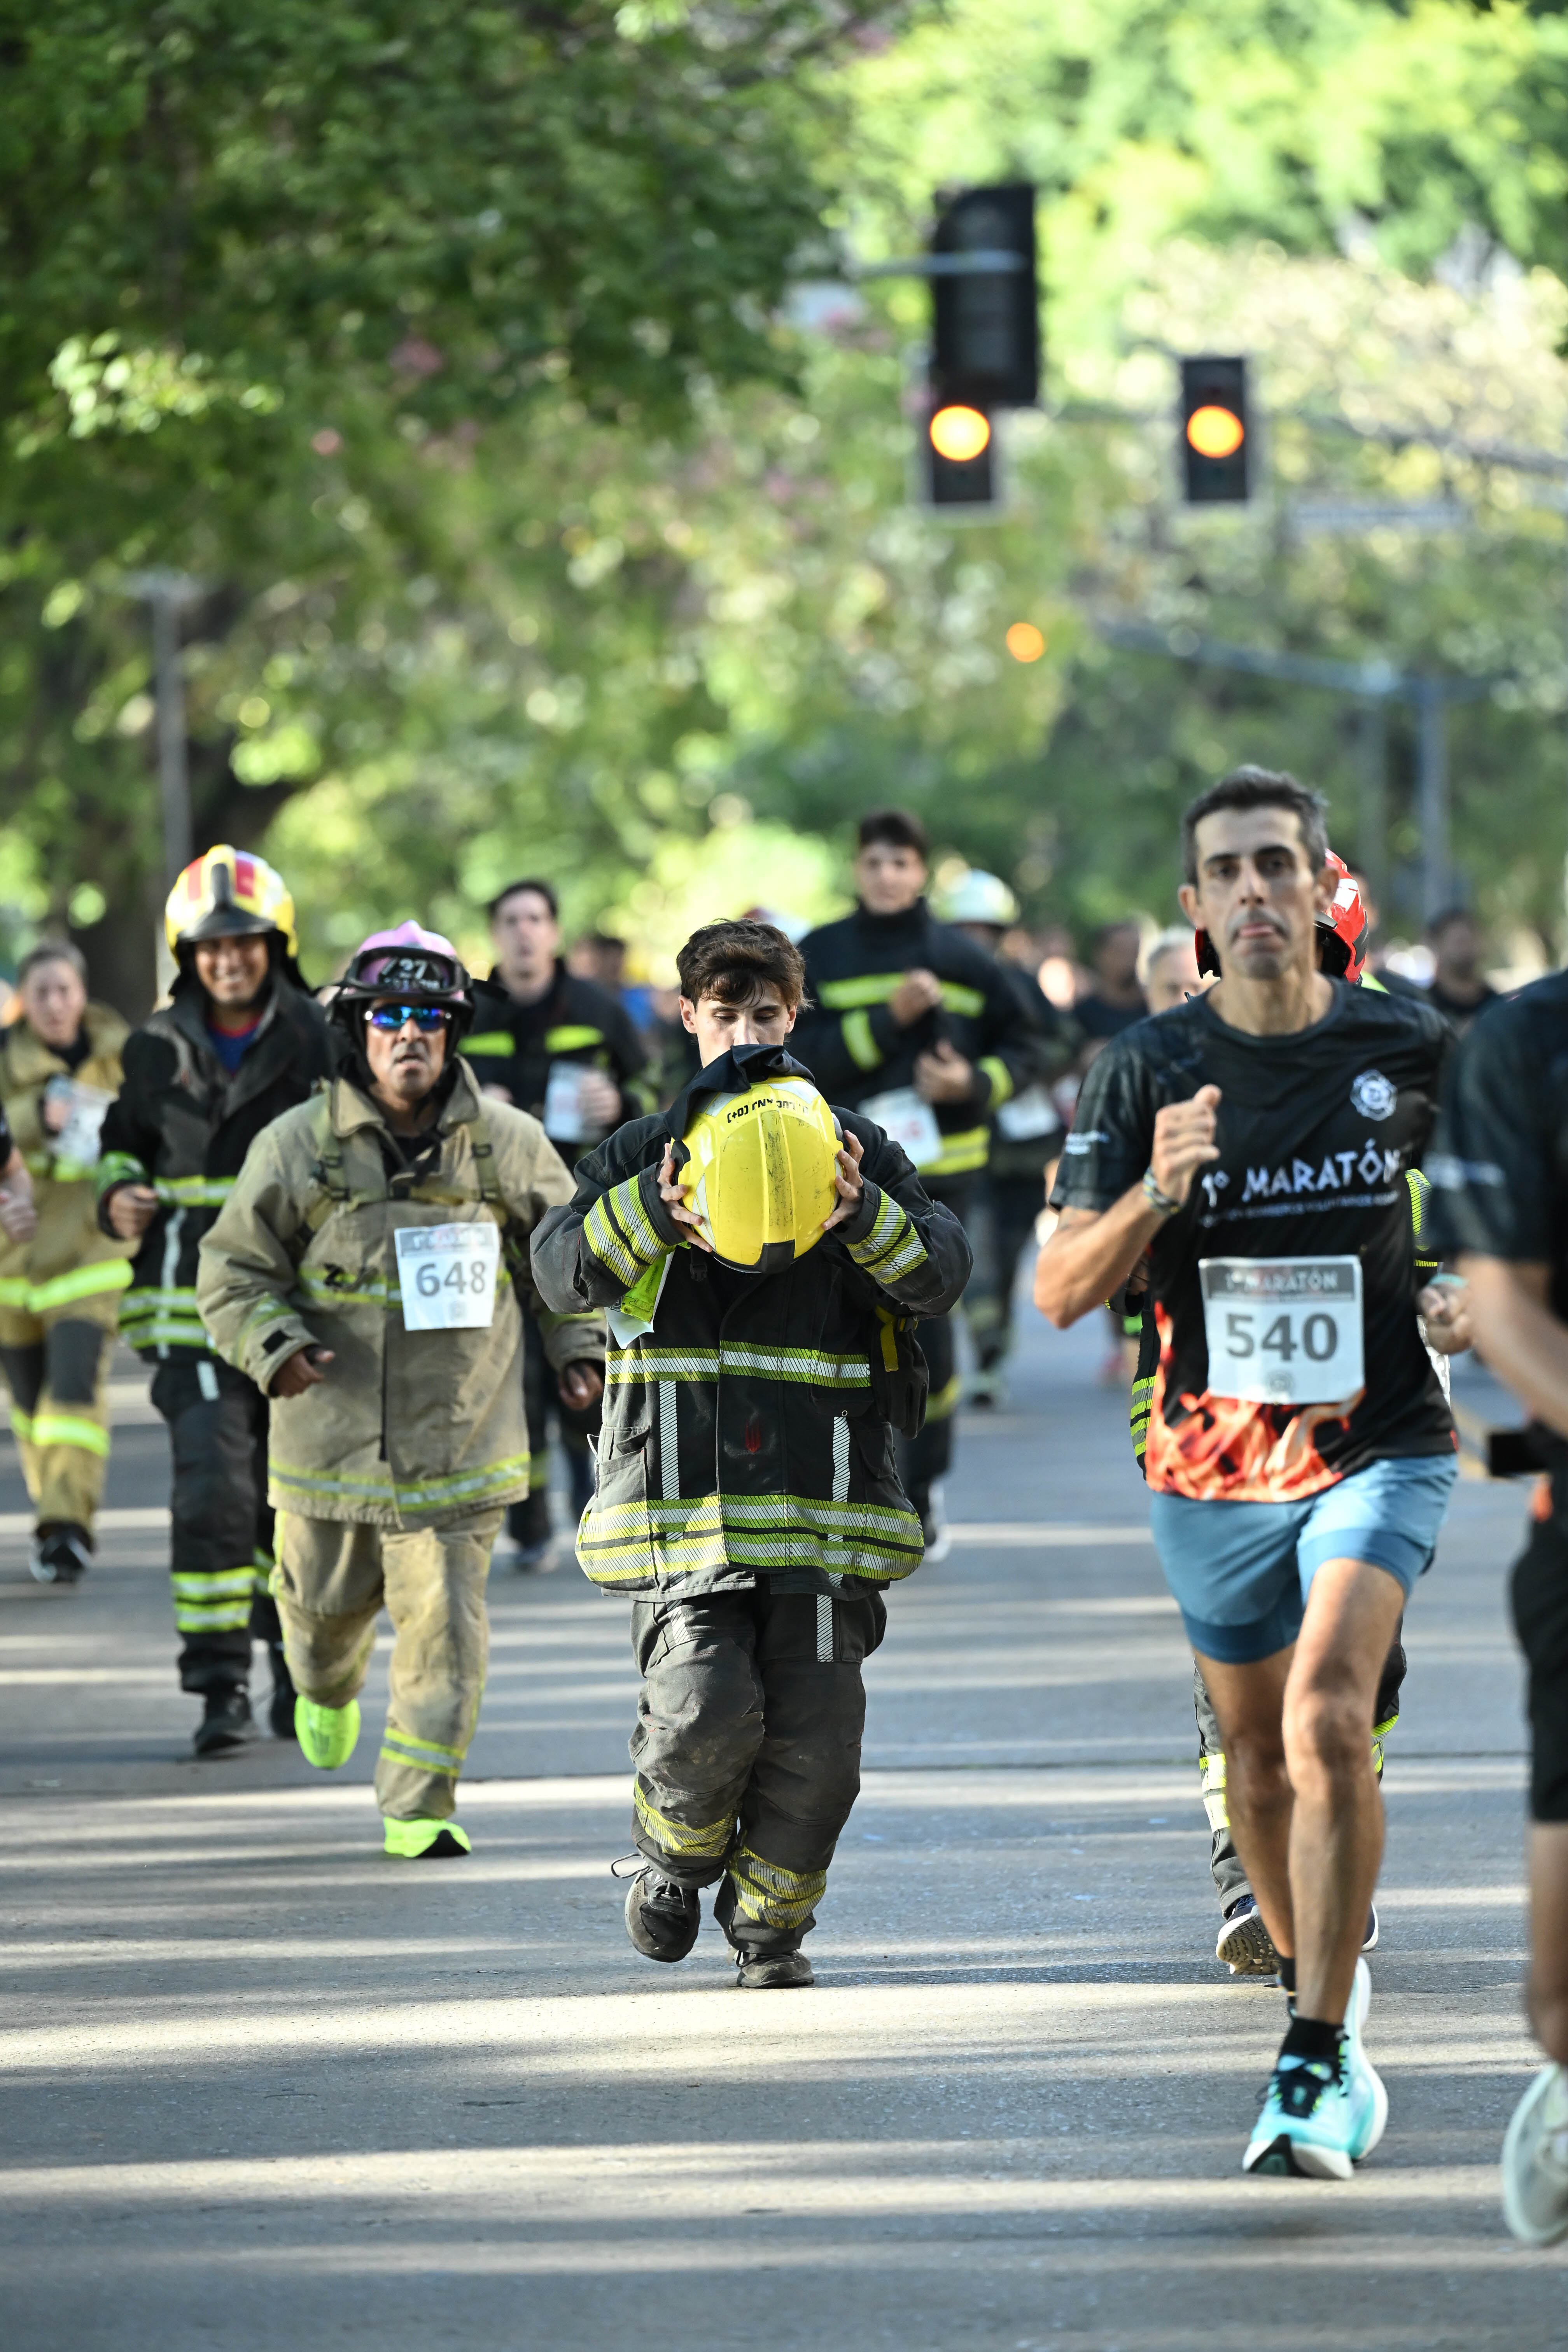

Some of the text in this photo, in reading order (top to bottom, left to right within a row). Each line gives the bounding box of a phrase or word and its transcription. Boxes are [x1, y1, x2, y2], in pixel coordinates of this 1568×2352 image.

[399, 958, 427, 979] 27
[1242, 1138, 1400, 1202] MARATÓN
[416, 1261, 485, 1297] 648
[1227, 1314, 1337, 1362] 540
